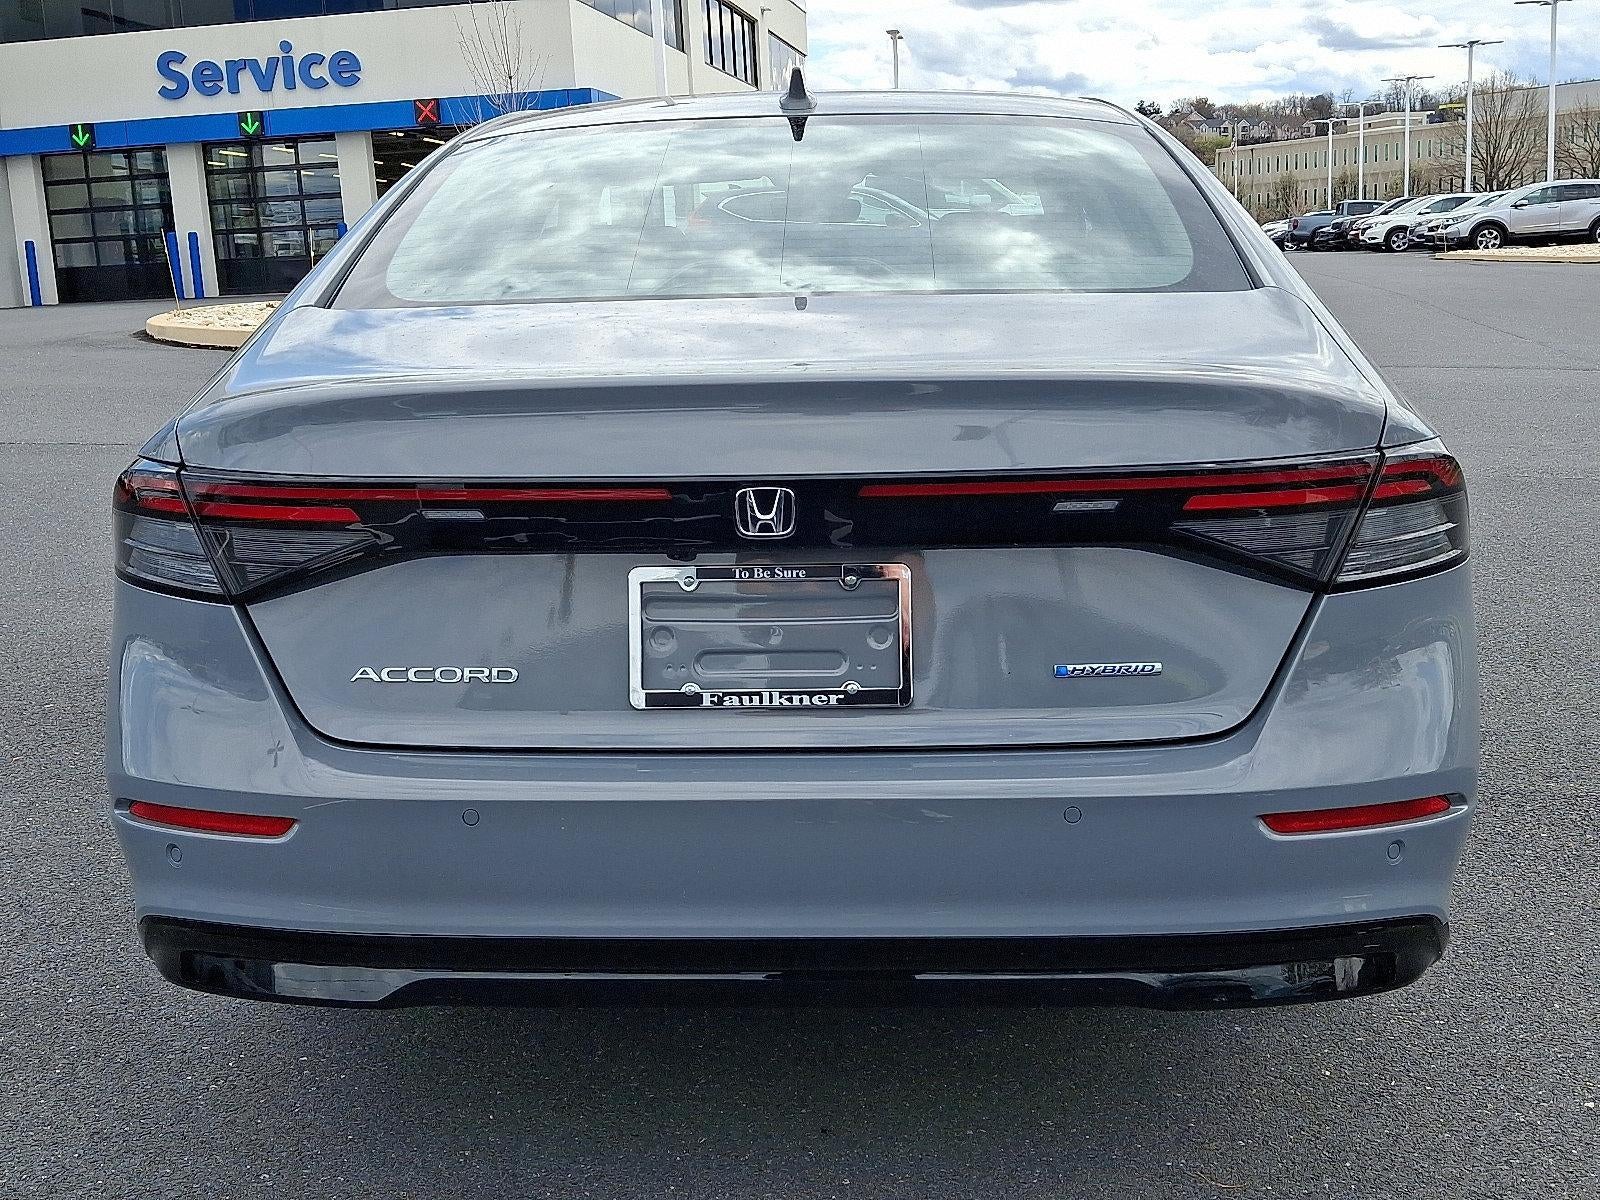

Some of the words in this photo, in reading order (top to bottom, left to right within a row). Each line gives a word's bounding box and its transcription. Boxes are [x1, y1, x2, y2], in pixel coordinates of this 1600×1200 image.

[156, 40, 361, 100] Service
[732, 567, 750, 579] To
[753, 567, 771, 579] Be
[774, 566, 806, 578] Sure
[350, 667, 519, 683] ACCORD
[1070, 664, 1156, 676] HYBRID
[700, 691, 845, 707] Faulkner
